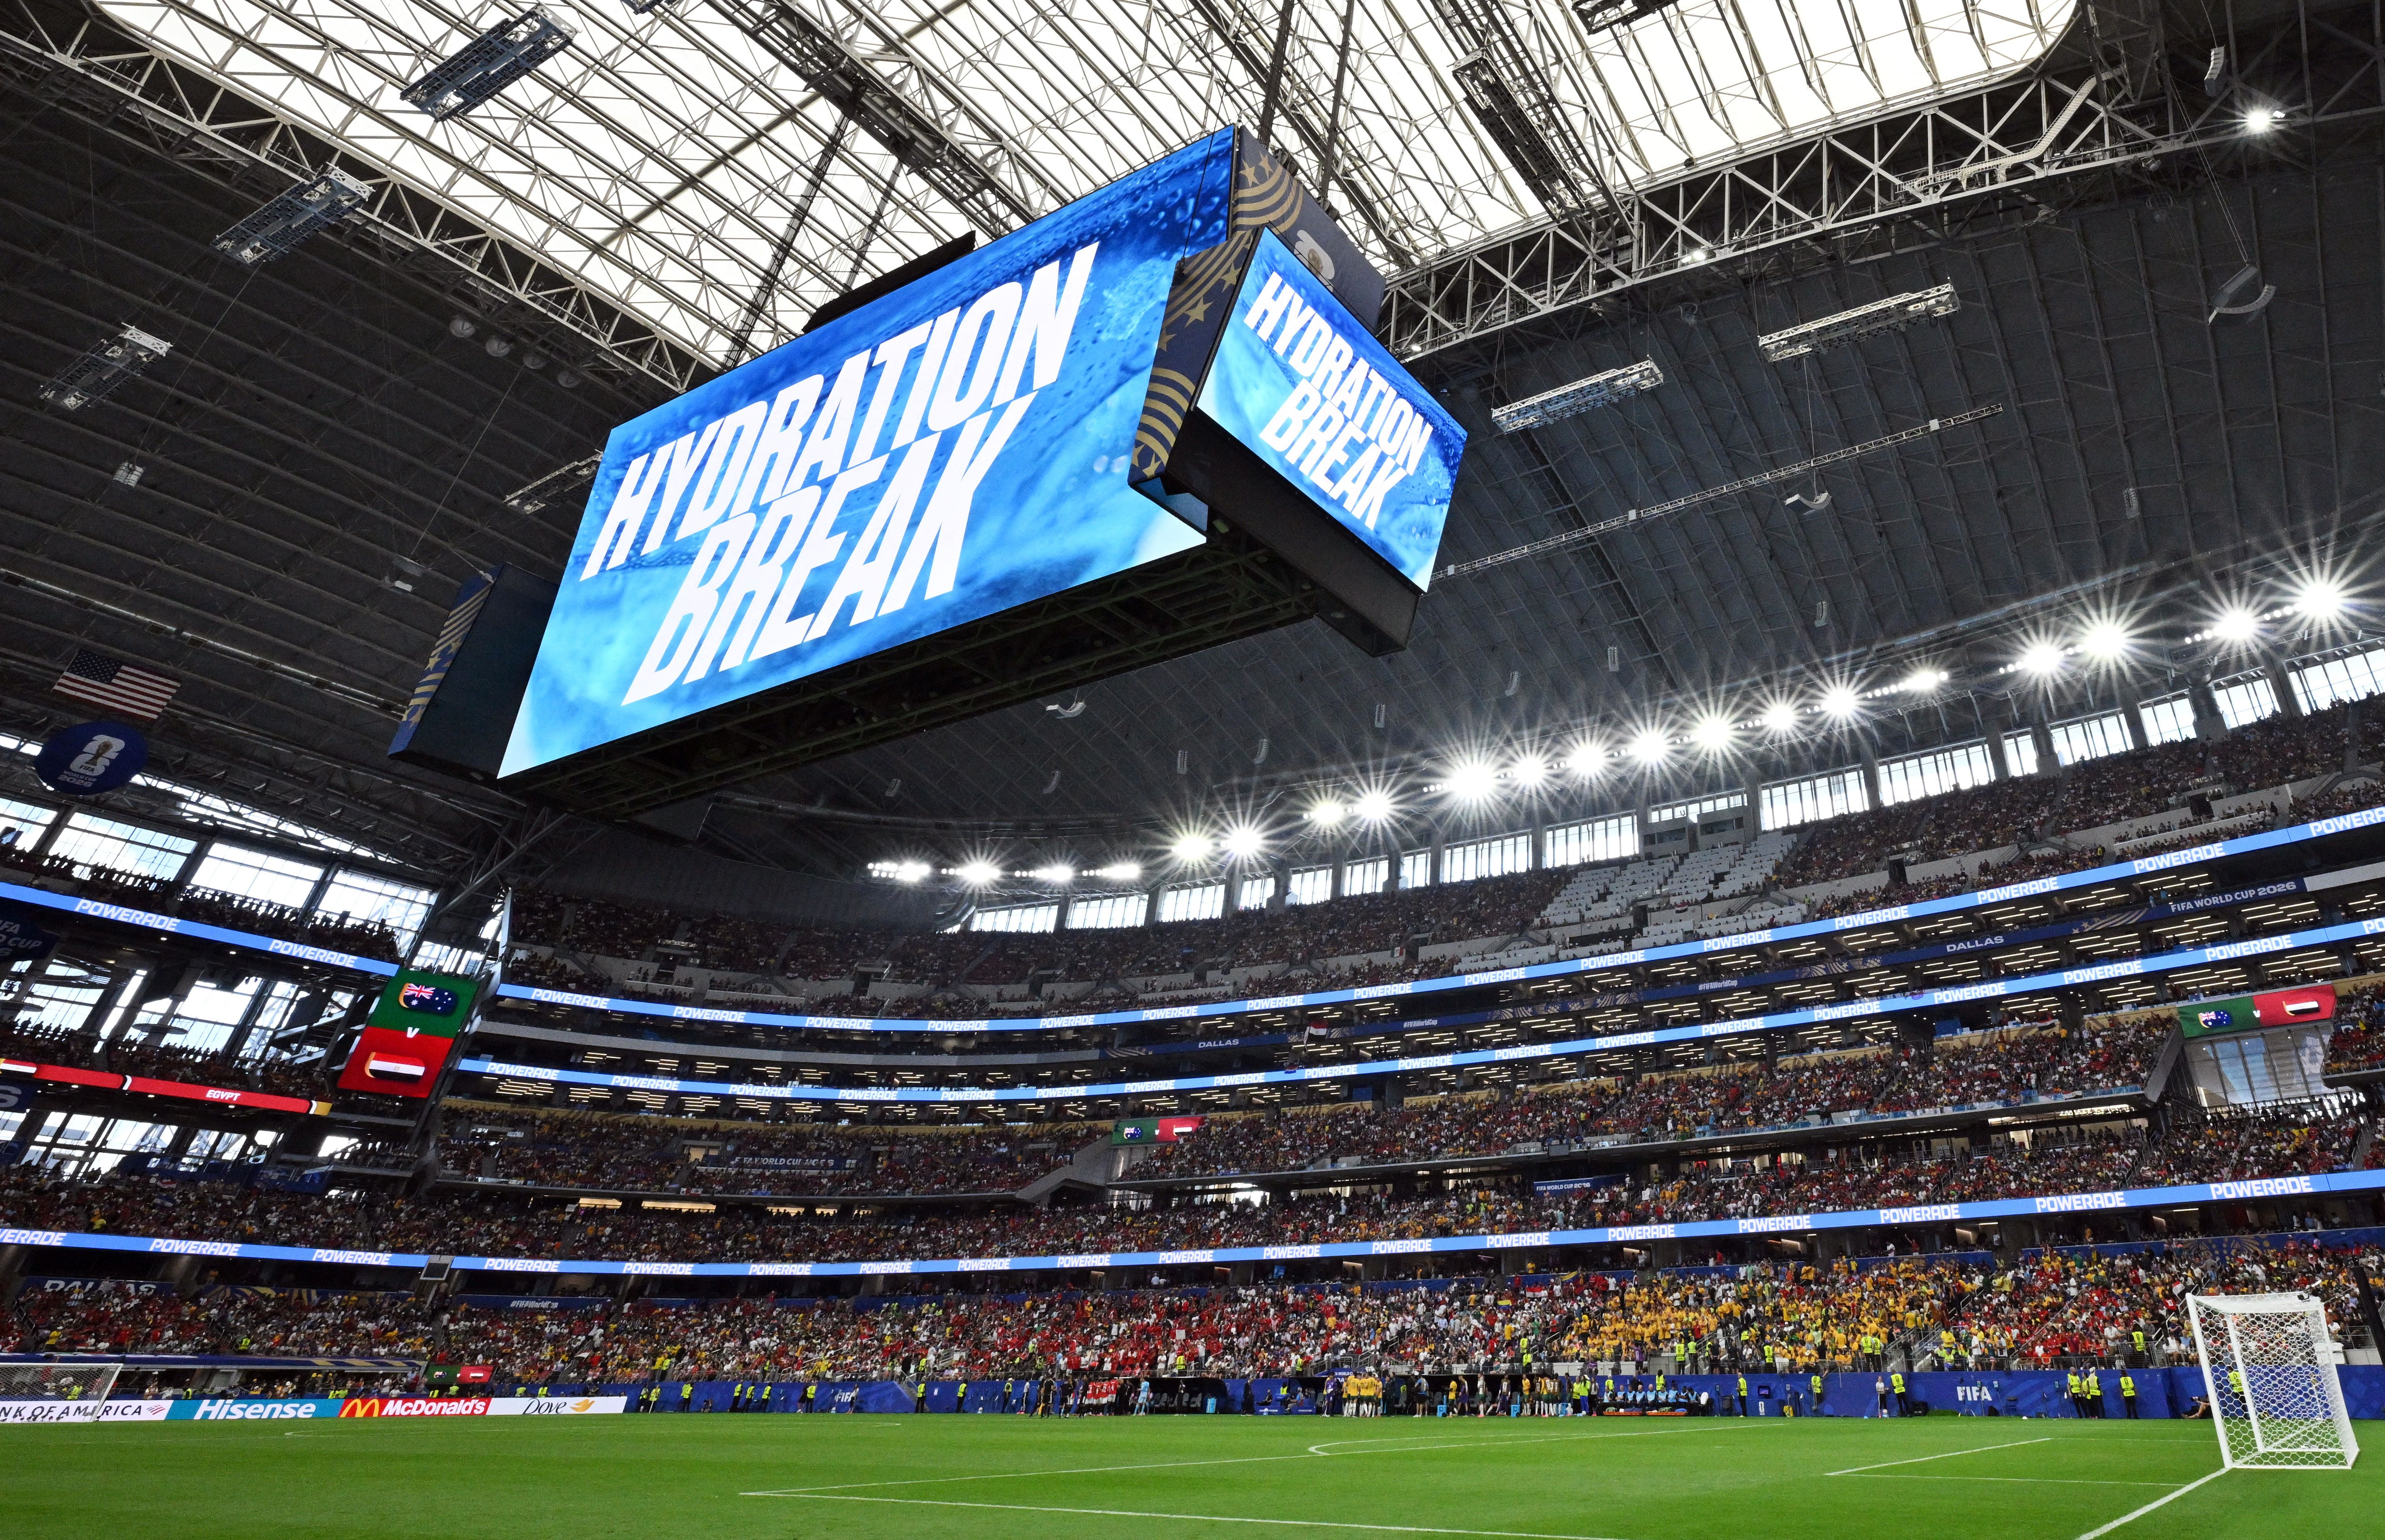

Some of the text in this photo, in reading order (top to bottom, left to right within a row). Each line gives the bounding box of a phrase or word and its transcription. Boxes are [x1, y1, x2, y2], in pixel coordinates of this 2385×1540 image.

[1244, 271, 1433, 476] HYDRATION
[579, 242, 1099, 581] HYDRATION
[1259, 377, 1407, 531] BREAK
[621, 391, 1037, 707] BREAK
[58, 774, 93, 788] 2026
[63, 770, 84, 779] WORLD
[2134, 843, 2225, 872] POWERADE
[1978, 878, 2059, 904] POWERADE
[2171, 881, 2296, 912] FIFA WORLD CUP 2026
[75, 899, 180, 931] POWERADE
[1835, 906, 1909, 929] POWERADE
[8, 937, 42, 949] CUP
[1704, 930, 1772, 951] POWERADE
[1946, 936, 2004, 952] DALLAS
[2205, 936, 2294, 960] POWERADE
[269, 940, 357, 966] POWERADE
[1581, 951, 1645, 970] POWERADE
[1465, 968, 1526, 985] POWERADE
[2064, 961, 2143, 984] POWERADE
[1354, 983, 1412, 998] POWERADE
[1699, 980, 1738, 991] #FIFAWorldCup
[1934, 983, 2006, 1003] POWERADE
[531, 989, 610, 1009] POWERADE
[1247, 995, 1303, 1010] POWERADE
[674, 1007, 746, 1022] POWERADE
[1143, 1006, 1197, 1020] POWERADE
[1814, 1001, 1881, 1020] POWERADE
[806, 1018, 873, 1029] POWERADE
[928, 1021, 988, 1030] POWERADE
[1041, 1015, 1094, 1027] POWERADE
[1703, 1018, 1764, 1035] POWERADE
[1199, 1039, 1239, 1048] DALLAS
[1597, 1033, 1654, 1048] POWERADE
[1496, 1044, 1551, 1060] POWERADE
[1399, 1056, 1452, 1069] POWERADE
[487, 1063, 560, 1079] POWERADE
[1306, 1064, 1357, 1079] POWERADE
[612, 1076, 680, 1090] POWERADE
[1125, 1079, 1175, 1092] POWERADE
[1214, 1073, 1265, 1086] POWERADE
[206, 1089, 241, 1101] EGYPT
[729, 1086, 793, 1097] POWERADE
[839, 1090, 898, 1100] POWERADE
[942, 1090, 995, 1100] POWERADE
[1037, 1087, 1086, 1098] POWERADE
[2210, 1177, 2313, 1198] POWERADE
[2036, 1193, 2126, 1211] POWERADE
[1880, 1204, 1960, 1223] POWERADE
[1739, 1215, 1812, 1232] POWERADE
[1487, 1233, 1549, 1247] POWERADE
[1609, 1224, 1675, 1241] POWERADE
[150, 1239, 241, 1256] POWERADE
[1264, 1245, 1320, 1259] POWERADE
[1373, 1239, 1432, 1253] POWERADE
[313, 1249, 392, 1265] POWERADE
[1058, 1255, 1110, 1267] POWERADE
[1160, 1250, 1213, 1263] POWERADE
[485, 1258, 560, 1272] POWERADE
[623, 1263, 693, 1274] POWERADE
[749, 1264, 811, 1275] POWERADE
[860, 1262, 912, 1273] POWERADE
[958, 1259, 1010, 1271] POWERADE
[1957, 1386, 1993, 1401] FIFA
[31, 1406, 57, 1417] OF
[193, 1399, 316, 1420] Hisense
[381, 1399, 487, 1416] McDonald's
[522, 1397, 567, 1414] Dove
